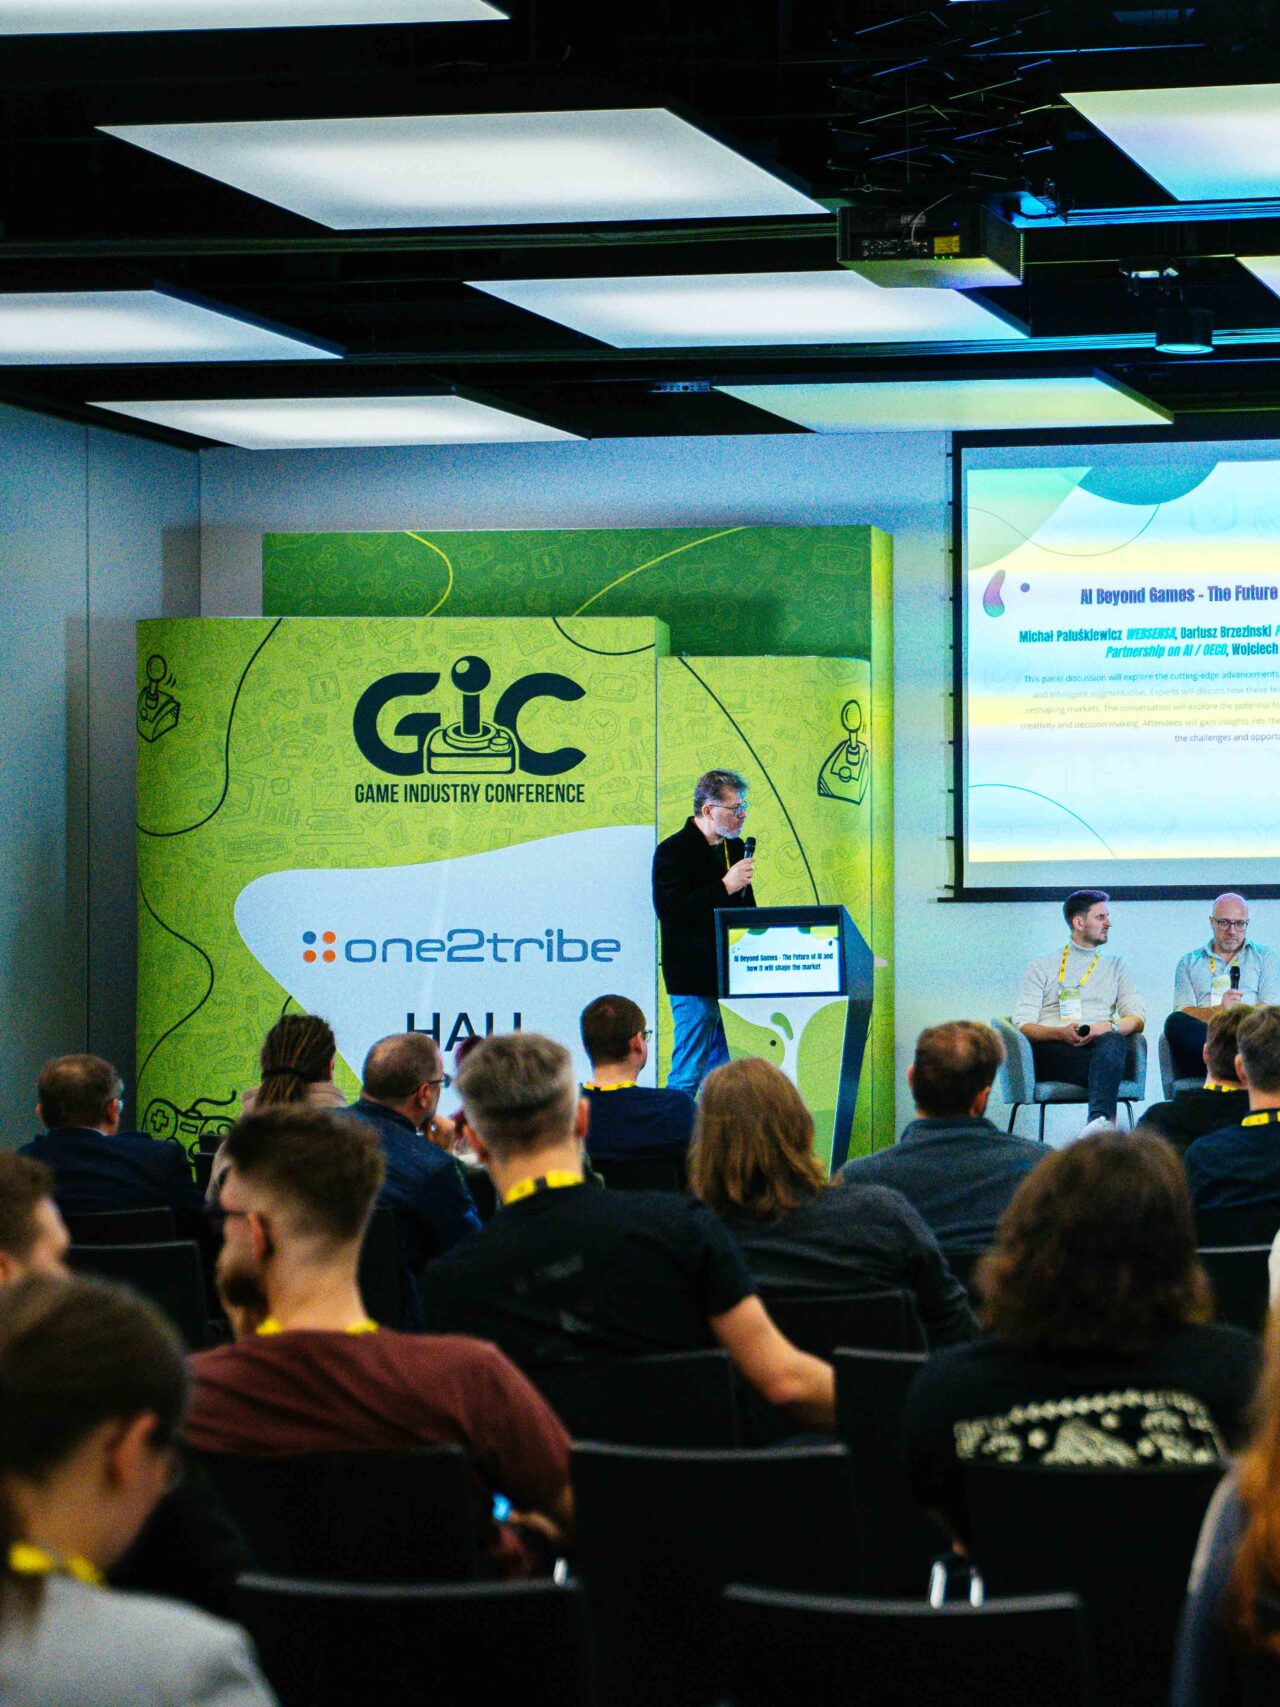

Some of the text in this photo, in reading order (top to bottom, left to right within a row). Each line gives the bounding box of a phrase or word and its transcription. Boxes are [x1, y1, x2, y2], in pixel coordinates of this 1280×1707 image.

[1080, 589, 1092, 604] AI
[1096, 588, 1146, 606] Beyond
[1149, 587, 1195, 603] Games
[1208, 586, 1231, 601] The
[1235, 585, 1278, 601] Future
[1180, 626, 1218, 639] Dariusz
[1220, 625, 1272, 638] Brzezinski
[1105, 644, 1165, 660] Partnership
[1167, 646, 1181, 656] on
[1182, 644, 1193, 656] AI
[1232, 642, 1279, 657] Wojciech
[1024, 675, 1040, 683] This
[1042, 674, 1064, 685] panel
[1065, 673, 1106, 682] discussion
[1108, 673, 1122, 681] will
[1124, 672, 1153, 683] explore
[1155, 672, 1168, 680] the
[1170, 671, 1219, 682] cutting-edge
[1221, 670, 1279, 679] advancements
[1174, 733, 1188, 741] the
[1190, 732, 1231, 743] challenges
[1233, 732, 1248, 740] and
[355, 784, 585, 803] GAME INDUSTRY CONFERENCE
[345, 928, 621, 963] one2tribe
